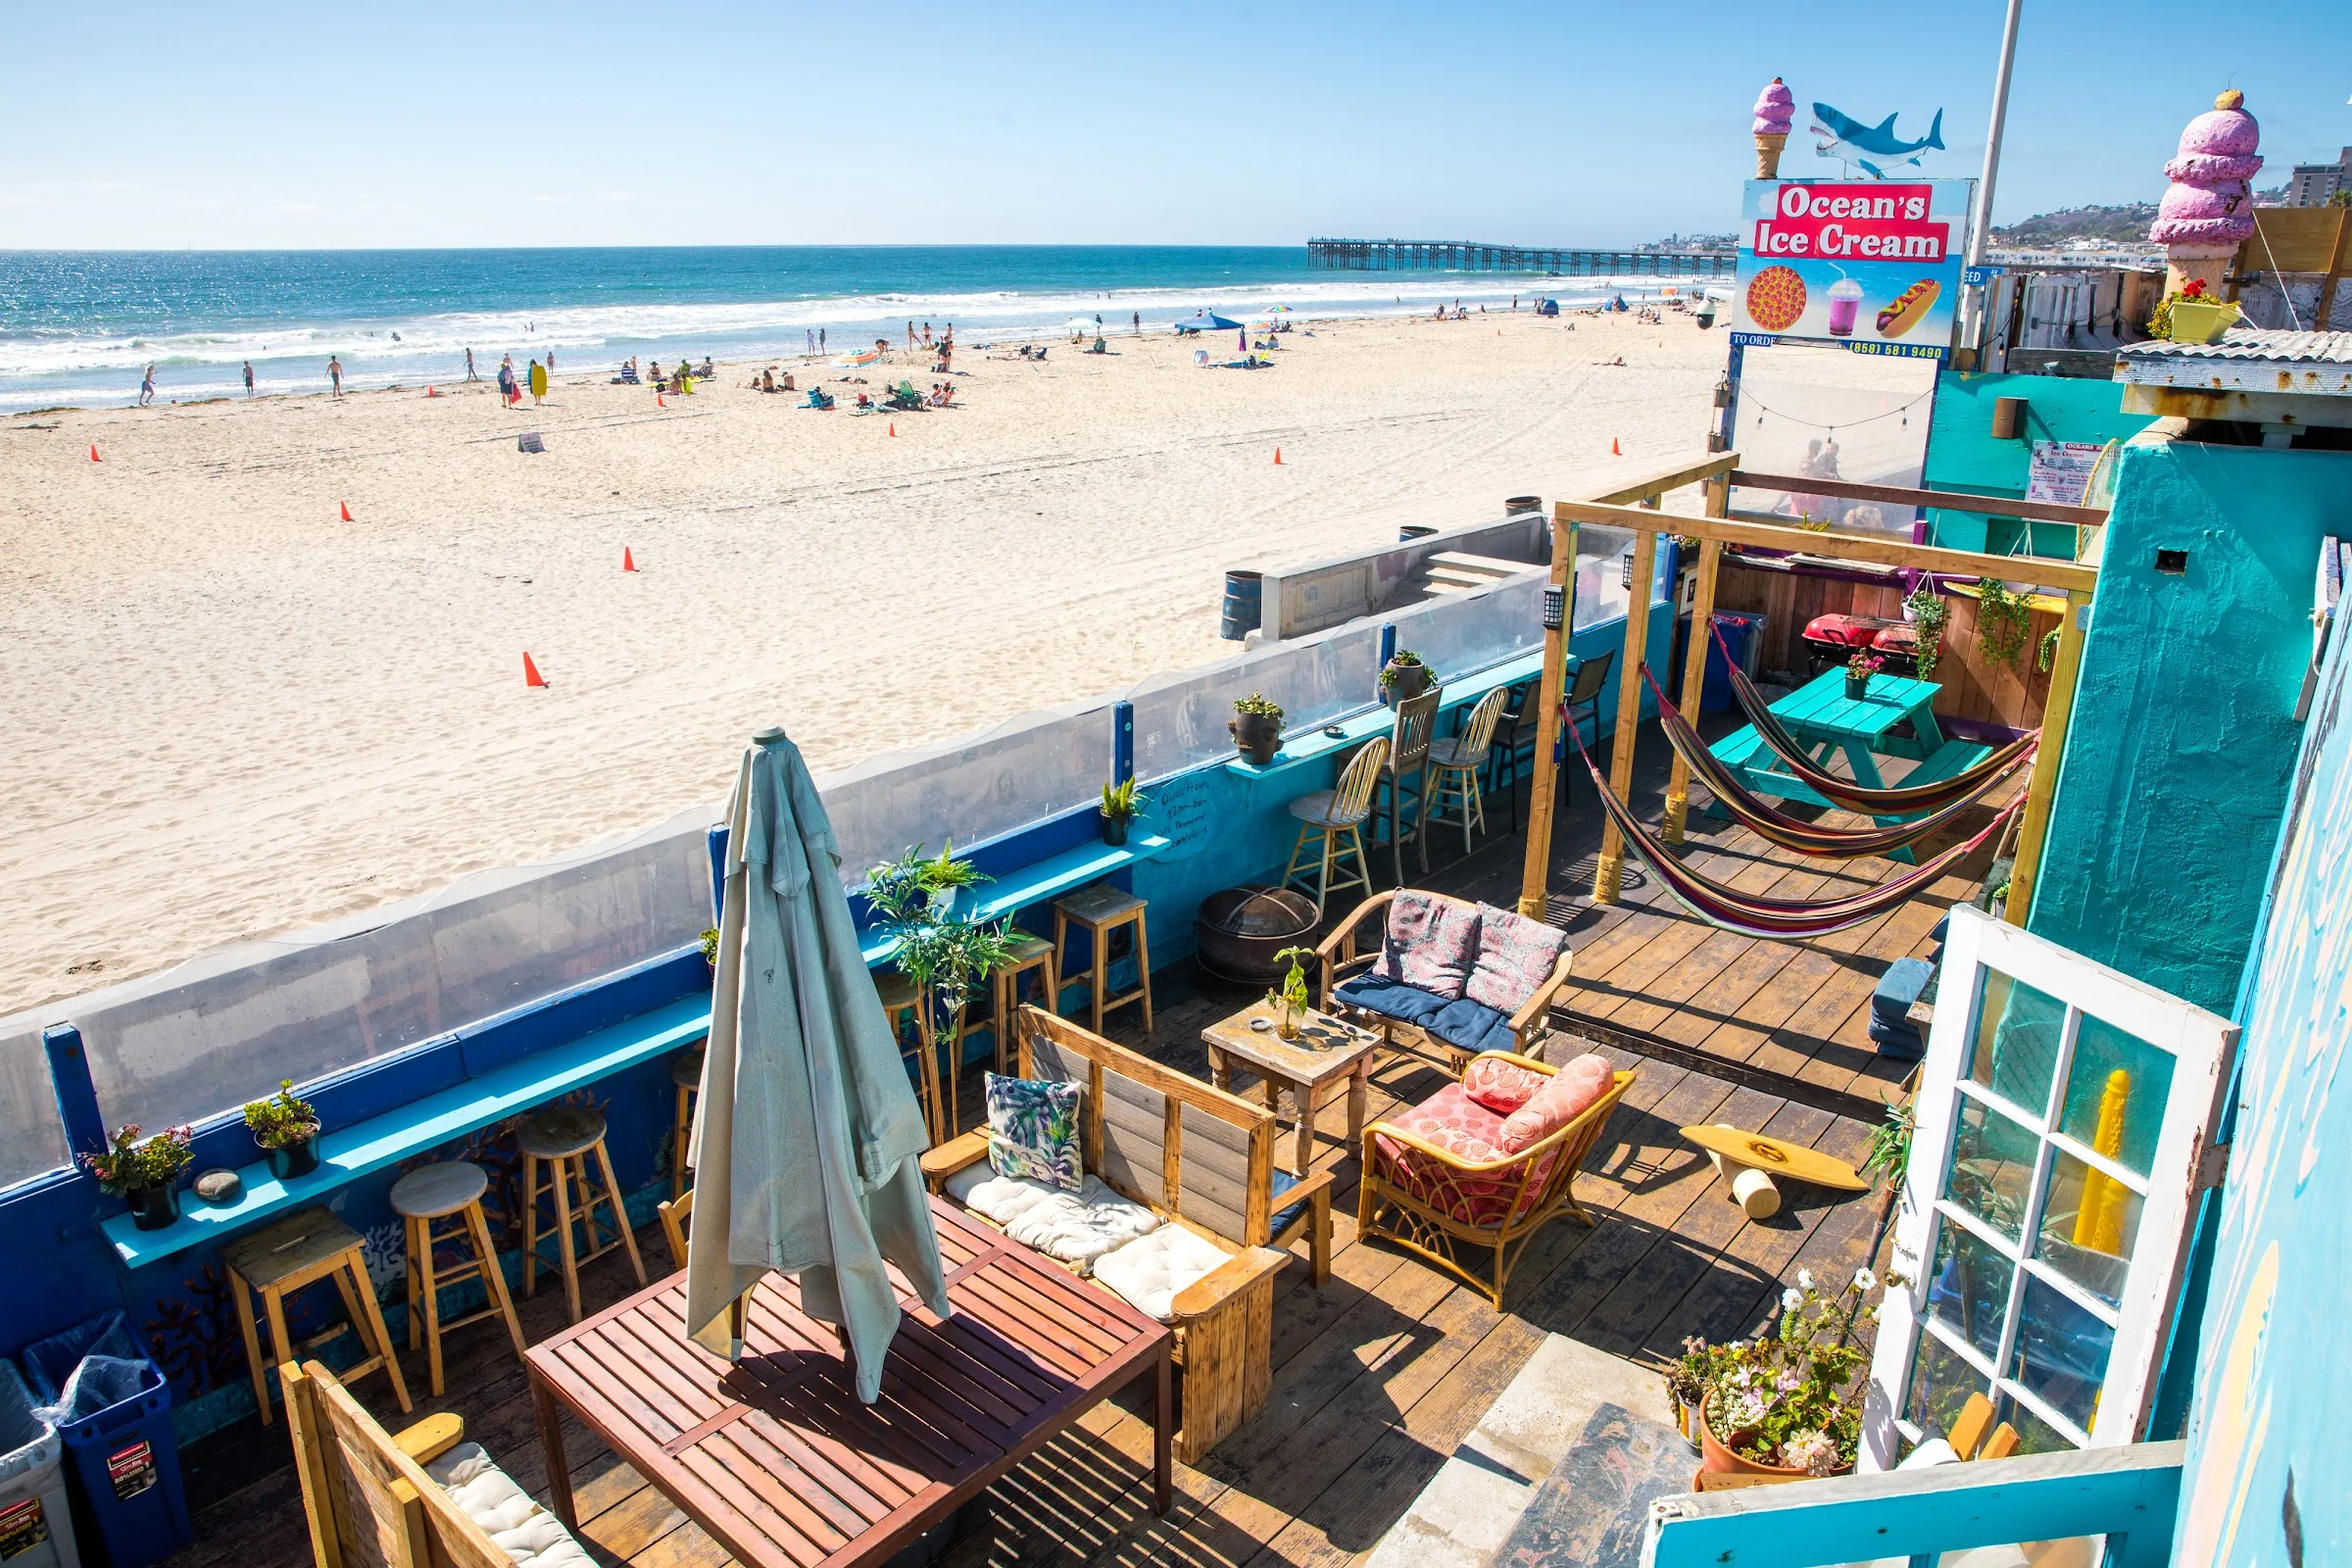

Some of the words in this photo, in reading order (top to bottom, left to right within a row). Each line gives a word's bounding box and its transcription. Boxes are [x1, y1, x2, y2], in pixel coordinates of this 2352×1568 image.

[1781, 186, 1926, 220] Ocean's
[1757, 222, 1809, 255] Ice
[1819, 223, 1939, 259] Cream
[1733, 333, 1747, 344] TO
[1849, 342, 1881, 355] (858)
[1885, 344, 1907, 357] 581
[1911, 346, 1941, 359] 9490
